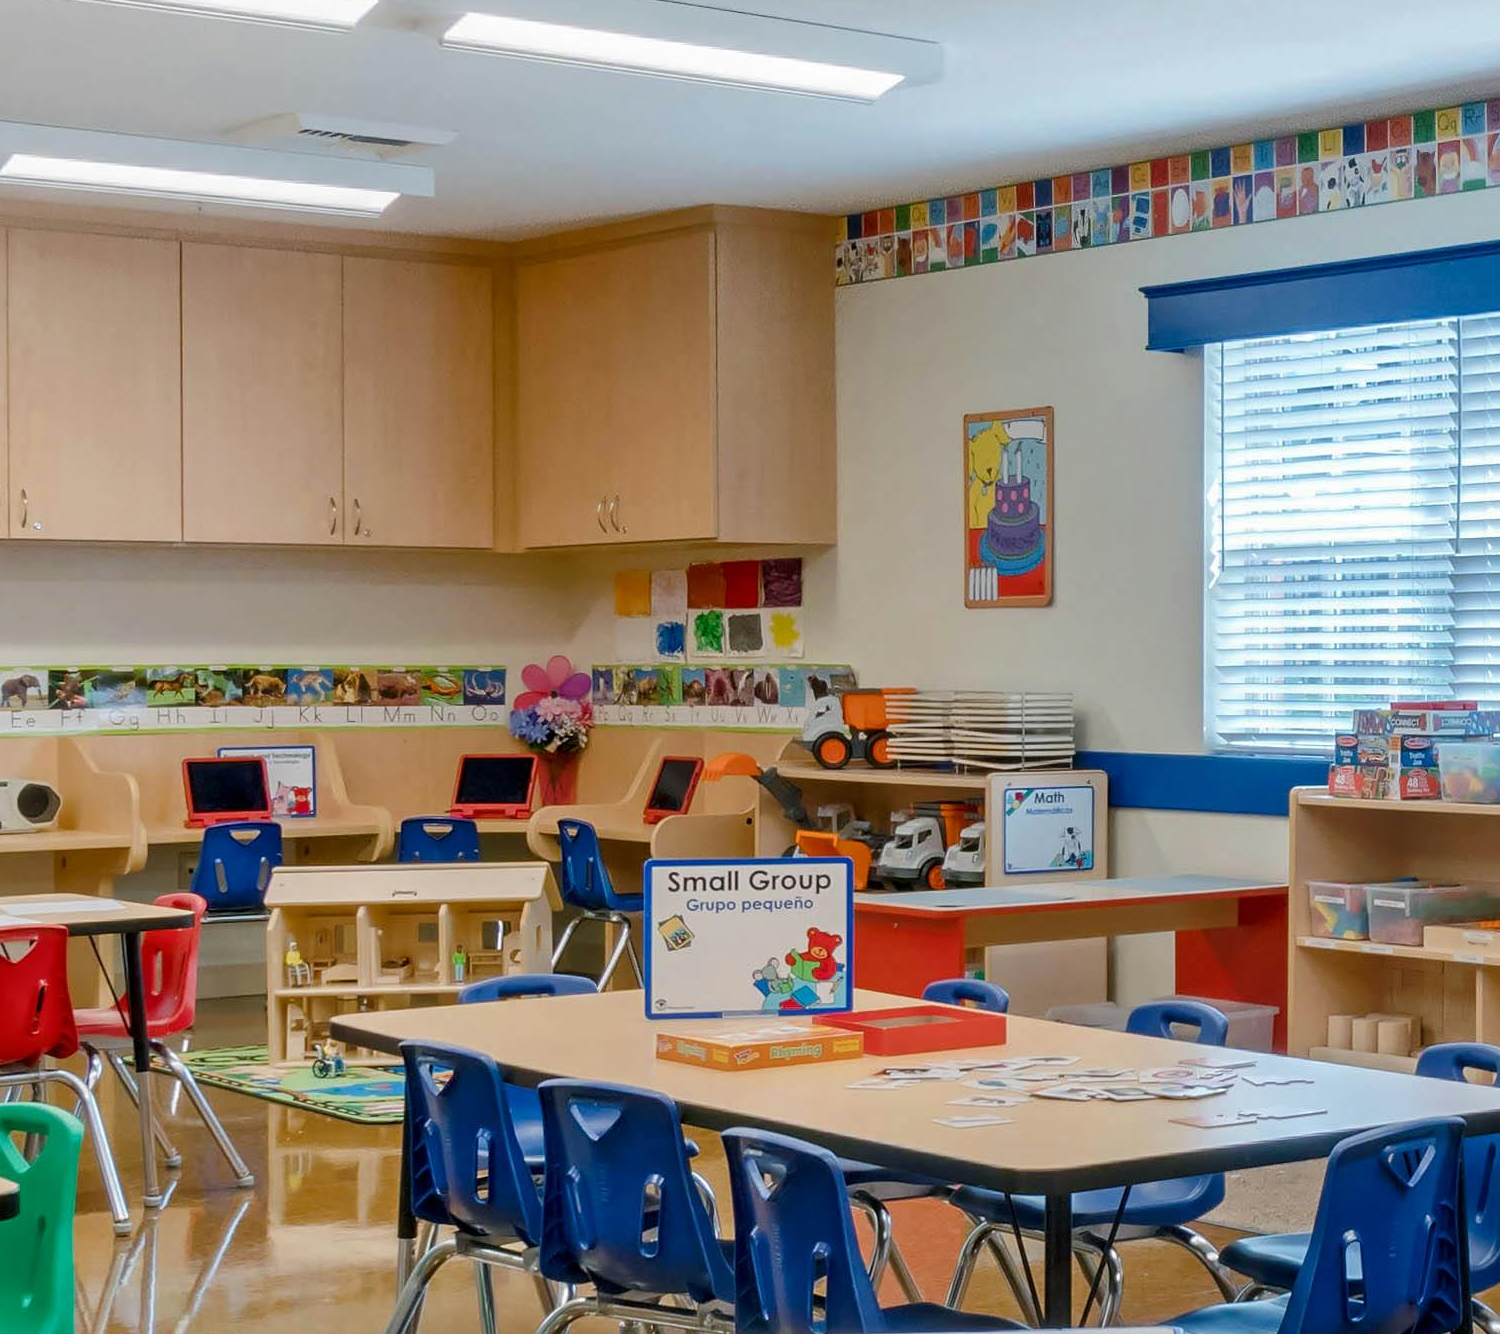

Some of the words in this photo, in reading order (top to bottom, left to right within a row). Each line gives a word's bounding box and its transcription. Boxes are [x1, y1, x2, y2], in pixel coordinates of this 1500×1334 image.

[1035, 792, 1064, 803] Math
[667, 871, 739, 893] Small
[749, 871, 831, 894] Group
[686, 898, 736, 913] Grupo
[742, 896, 813, 913] pequeño
